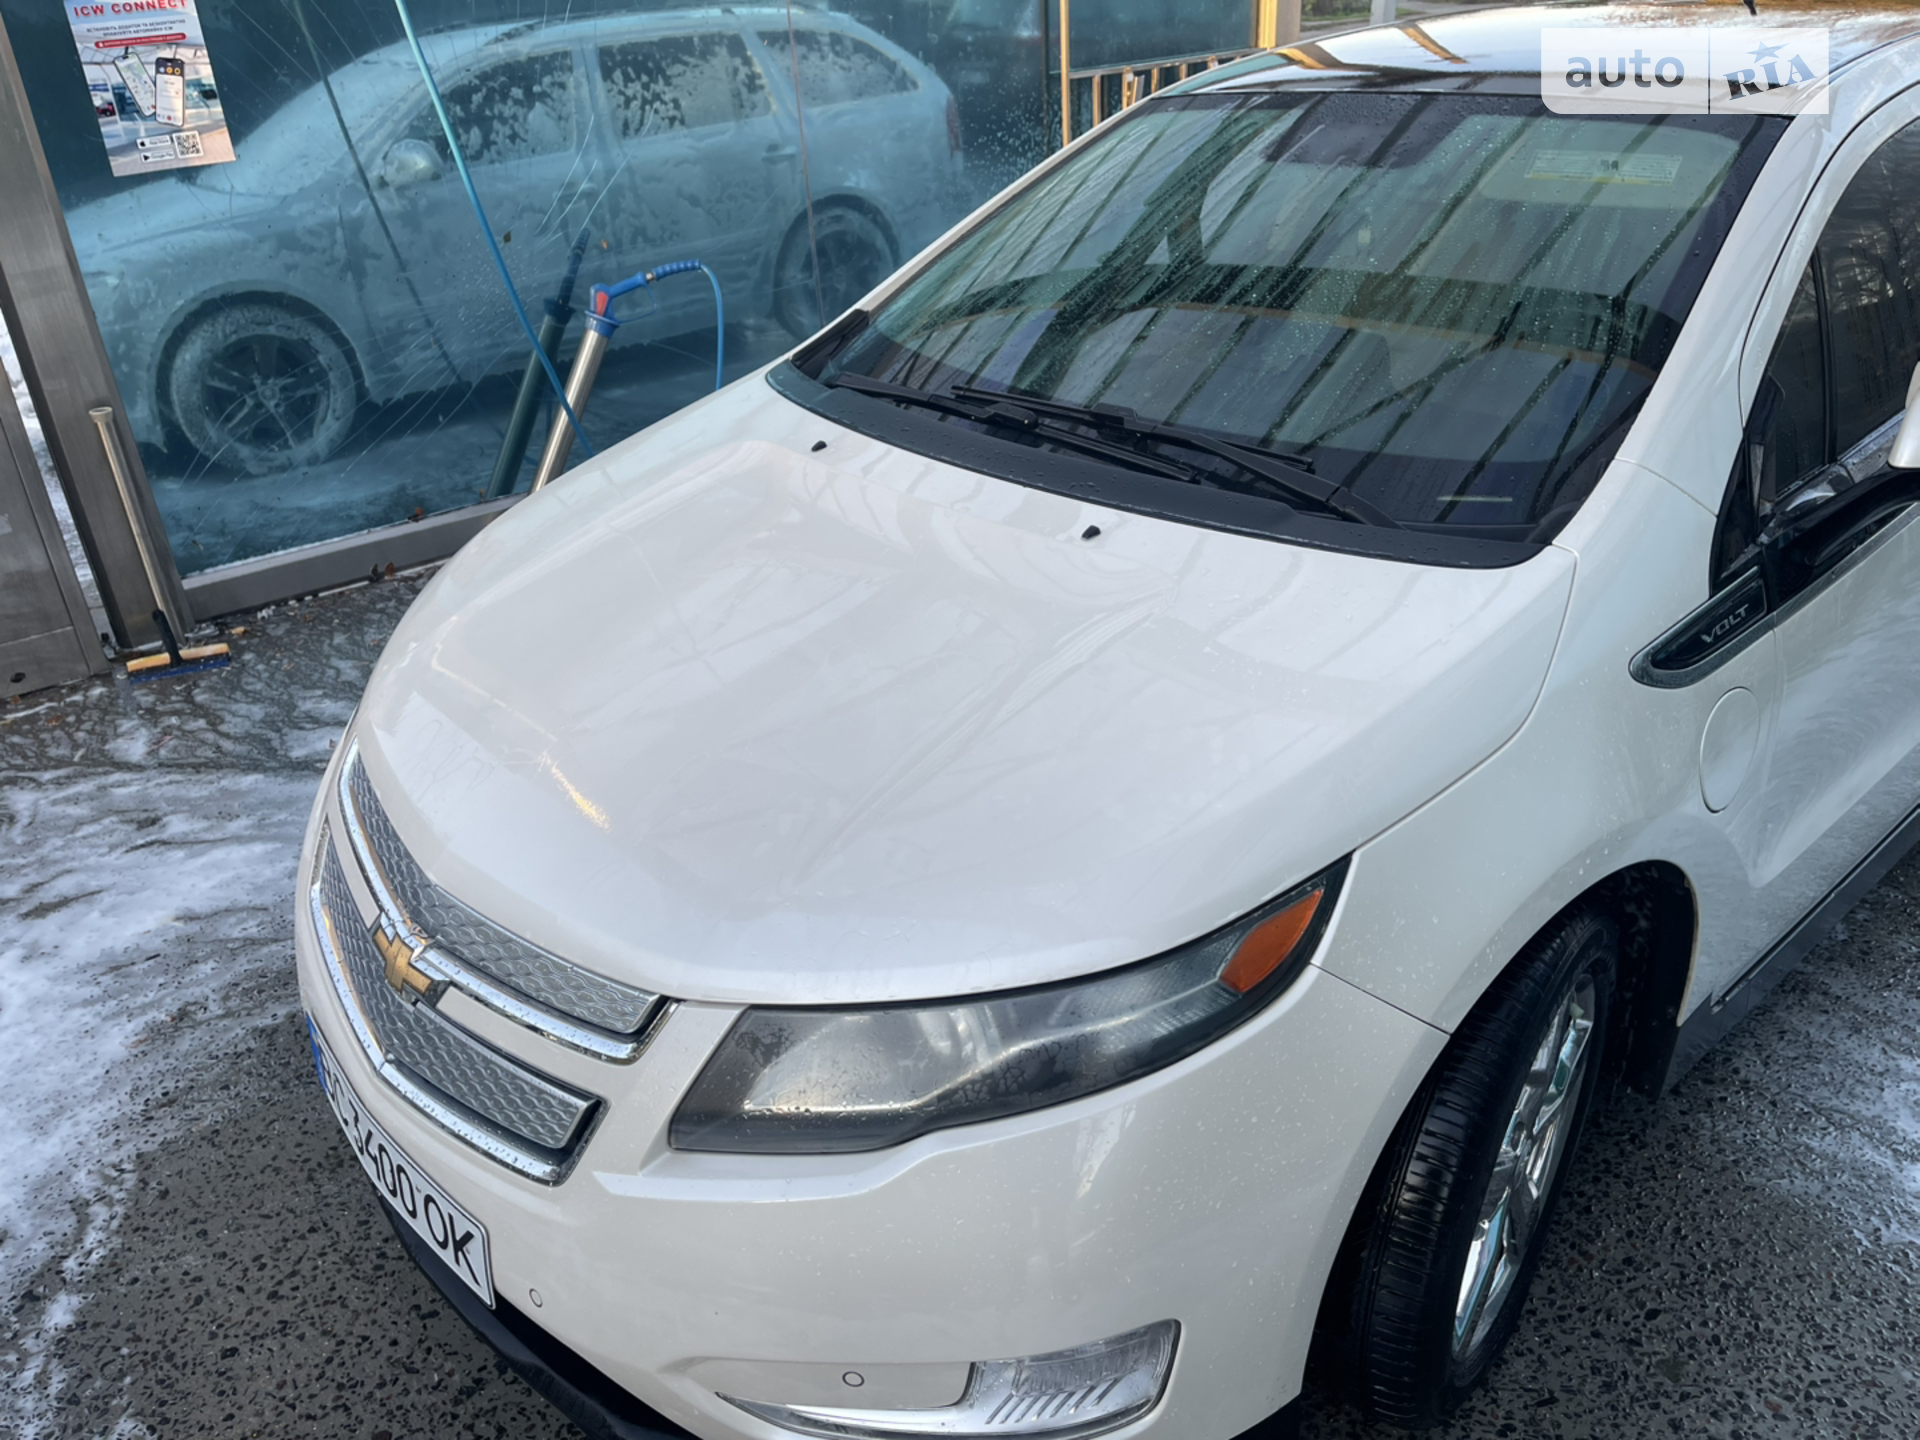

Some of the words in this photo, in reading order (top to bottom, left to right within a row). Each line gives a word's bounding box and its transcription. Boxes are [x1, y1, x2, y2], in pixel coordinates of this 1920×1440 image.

[74, 5, 105, 17] ICW
[111, 0, 187, 14] CONNECT
[1700, 603, 1749, 643] VOLT
[348, 1097, 417, 1220] 3400
[423, 1193, 481, 1287] OK
